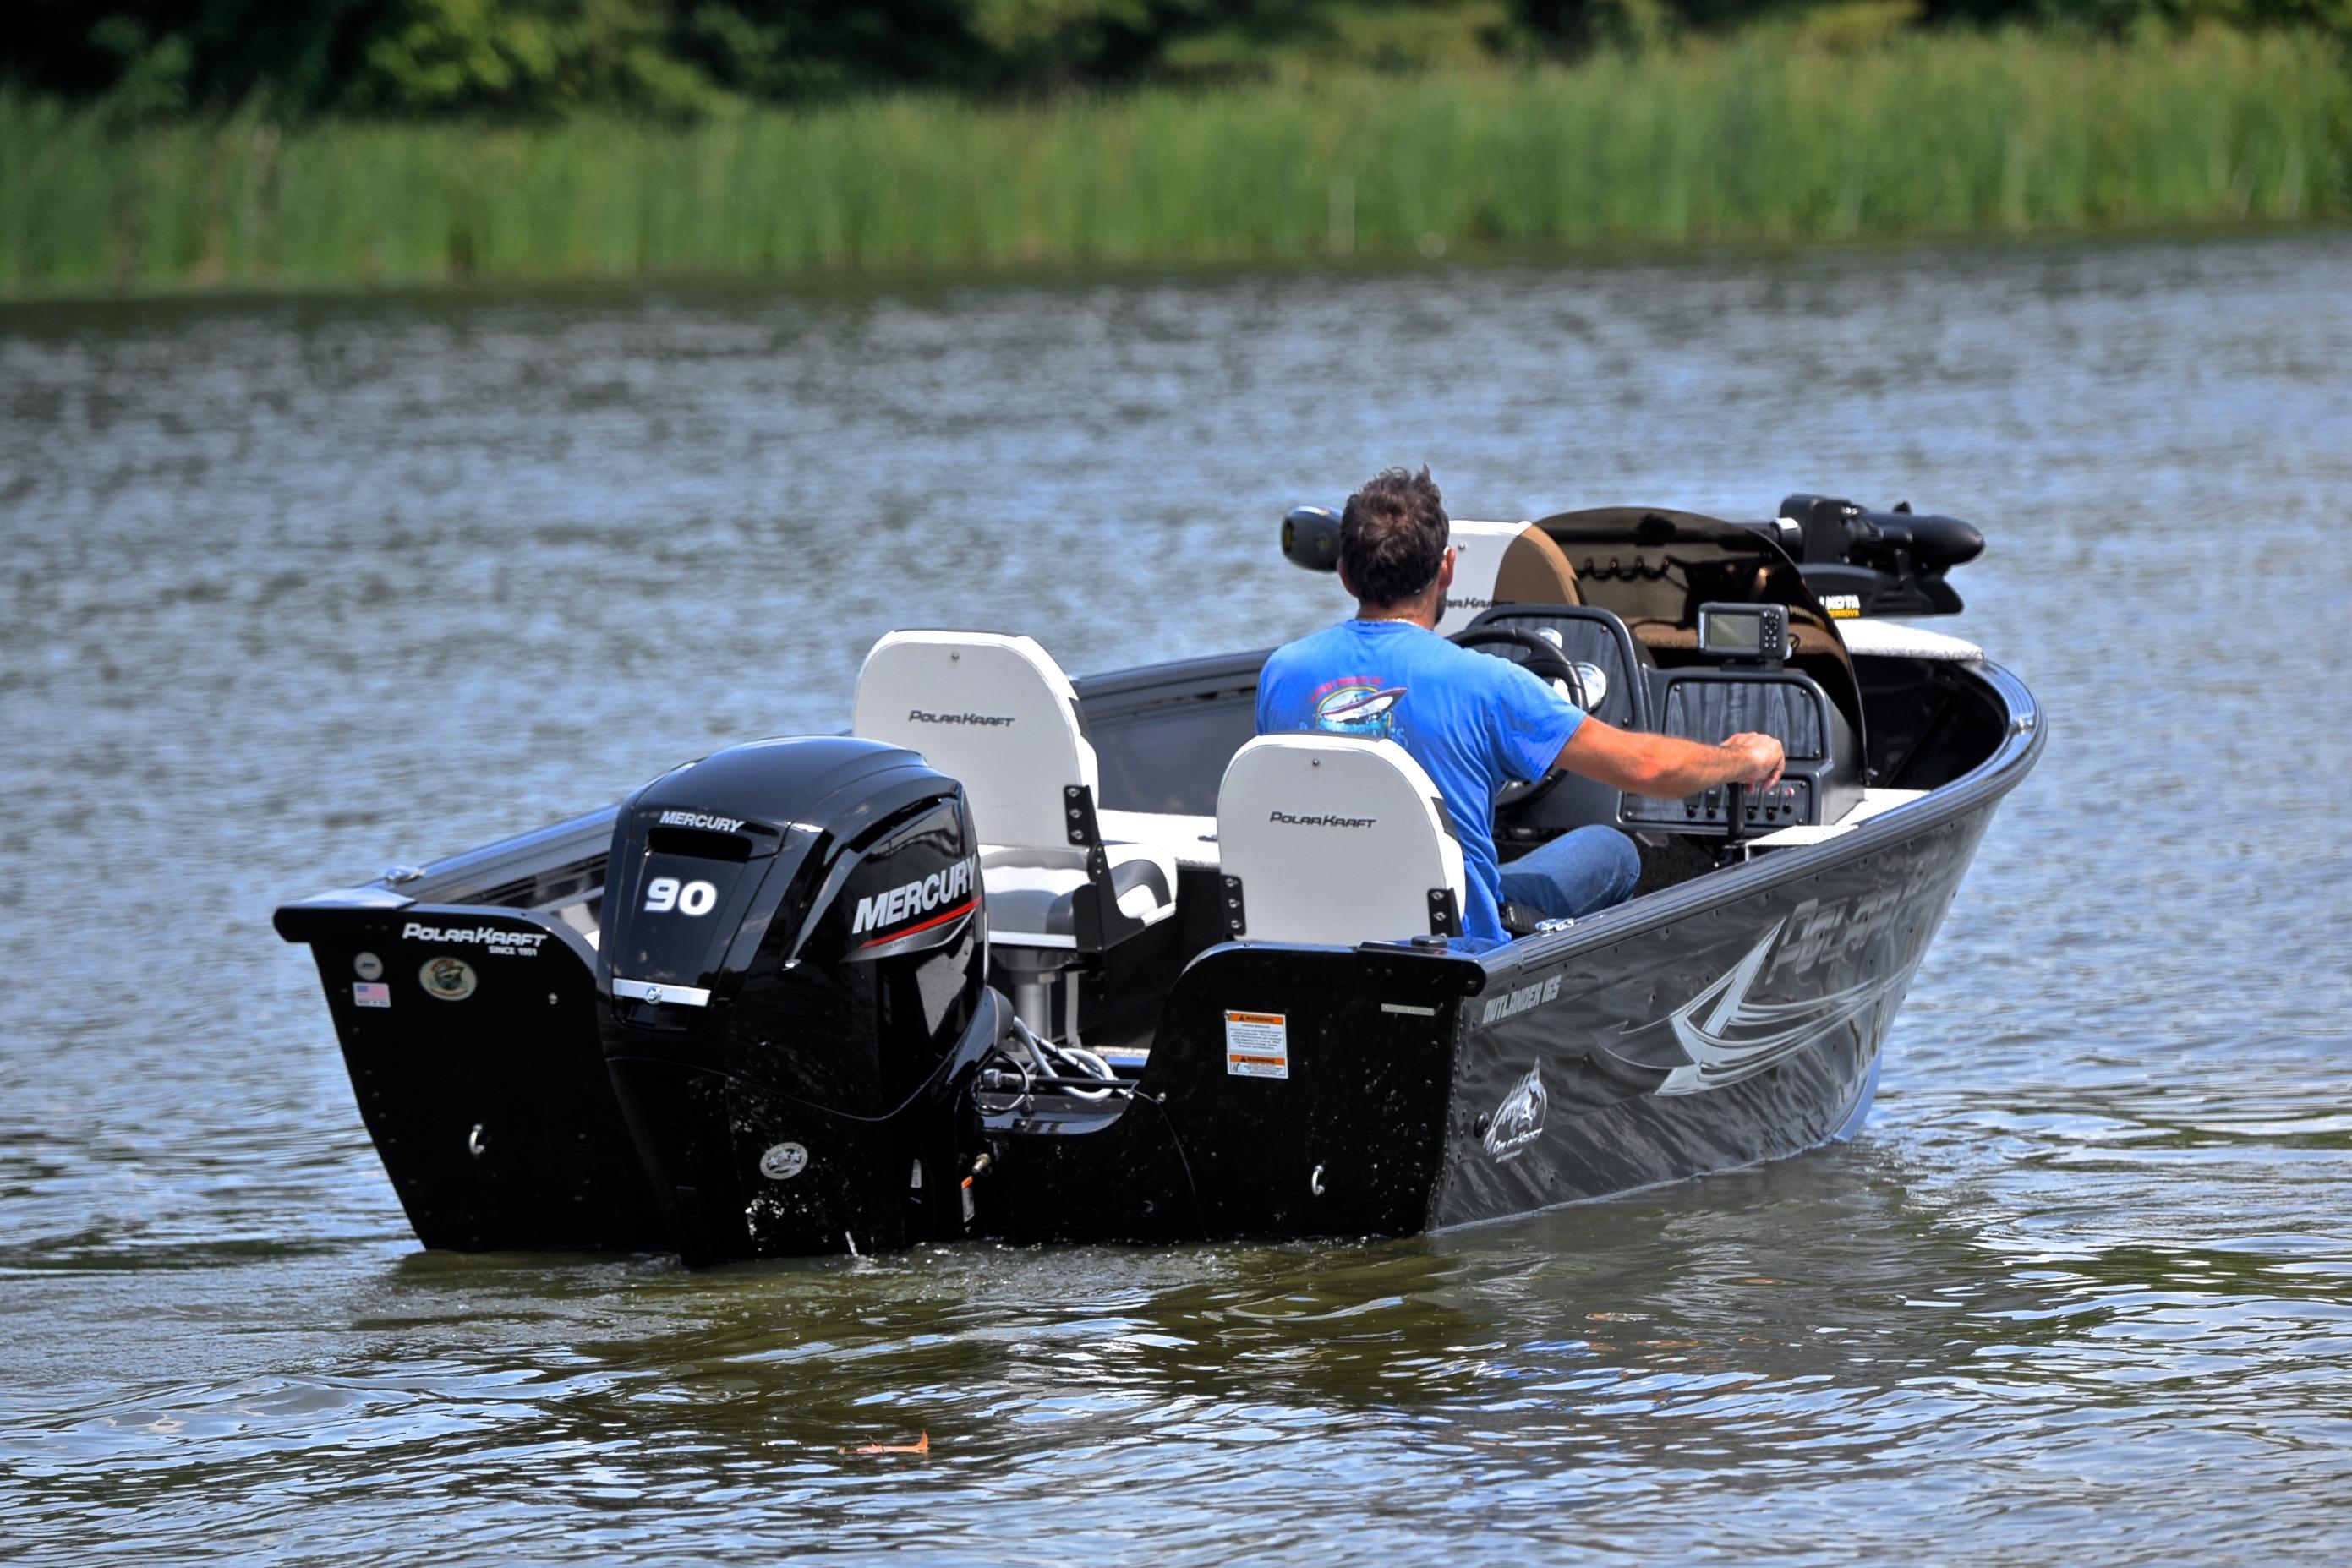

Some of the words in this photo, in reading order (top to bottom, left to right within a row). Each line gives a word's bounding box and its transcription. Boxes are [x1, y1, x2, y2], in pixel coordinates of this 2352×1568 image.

[659, 811, 745, 833] MERCURY
[643, 876, 718, 917] 90
[851, 854, 976, 935] MERCURY
[488, 945, 516, 955] SINCE
[1482, 981, 1544, 1025] OUTLANDER
[1541, 974, 1562, 1004] 165
